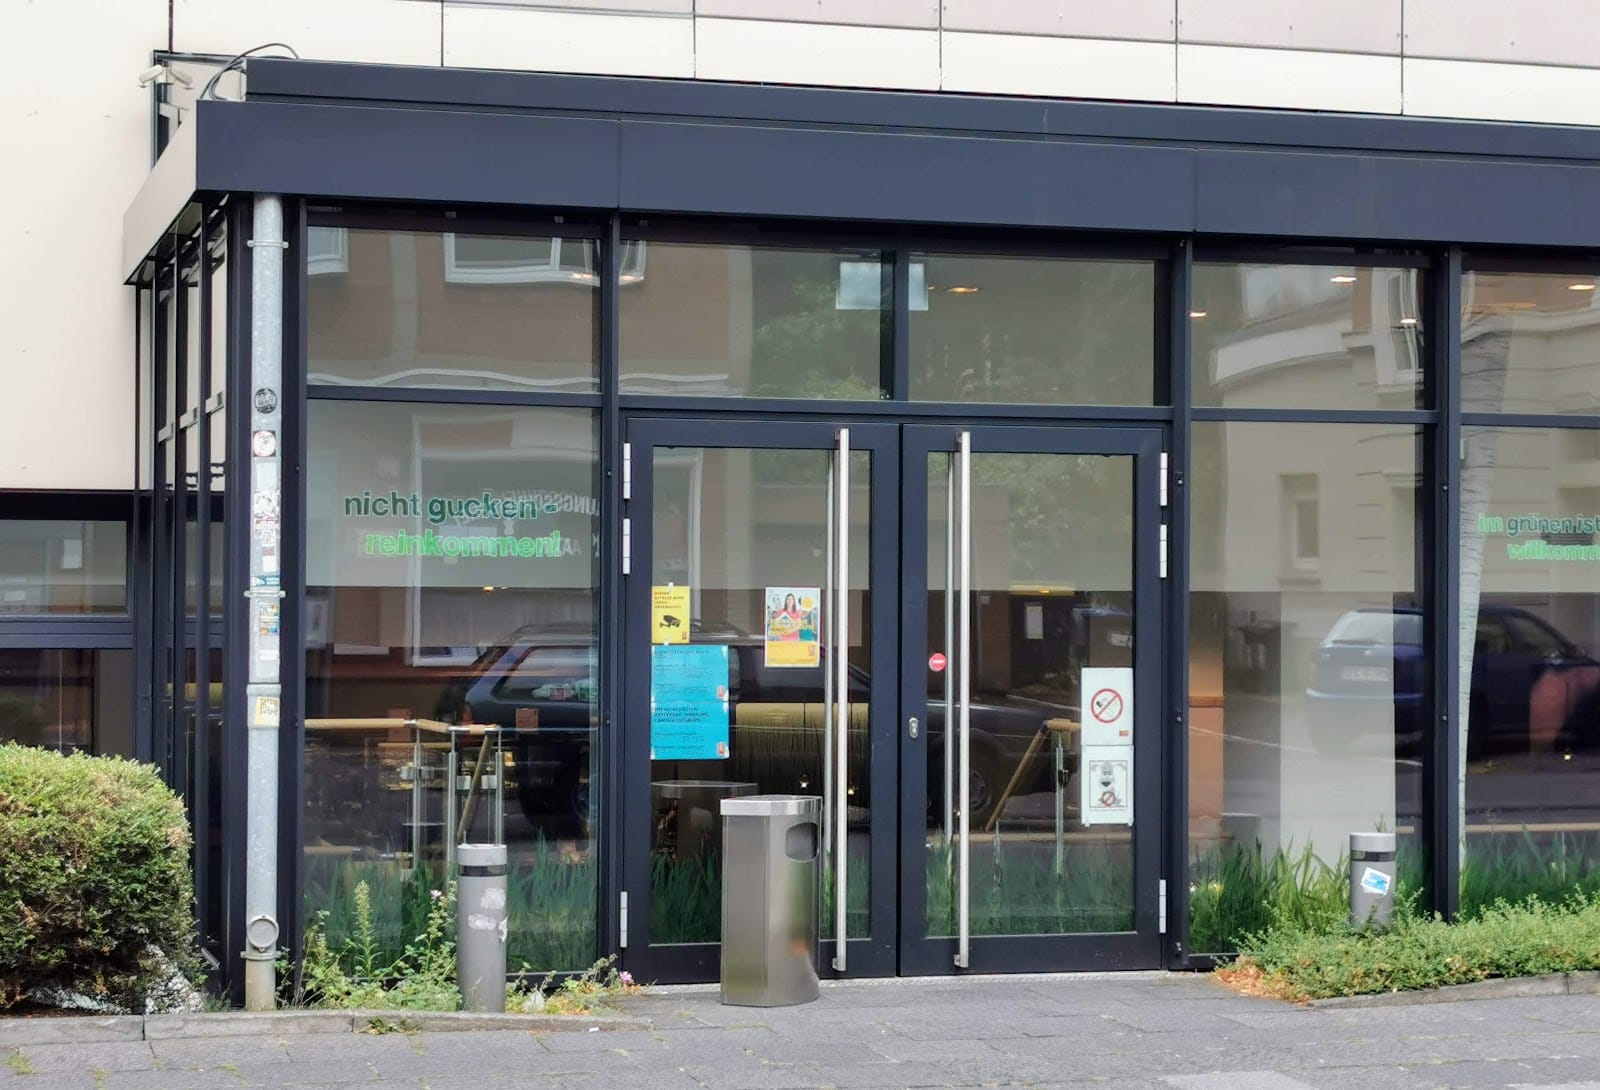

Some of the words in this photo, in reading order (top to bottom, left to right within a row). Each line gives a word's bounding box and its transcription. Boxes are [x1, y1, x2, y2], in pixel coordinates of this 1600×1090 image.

[344, 490, 422, 517] nicht
[428, 492, 537, 524] gucken
[1478, 513, 1503, 532] im
[1507, 513, 1573, 536] grünen
[366, 529, 561, 557] reinkommen!
